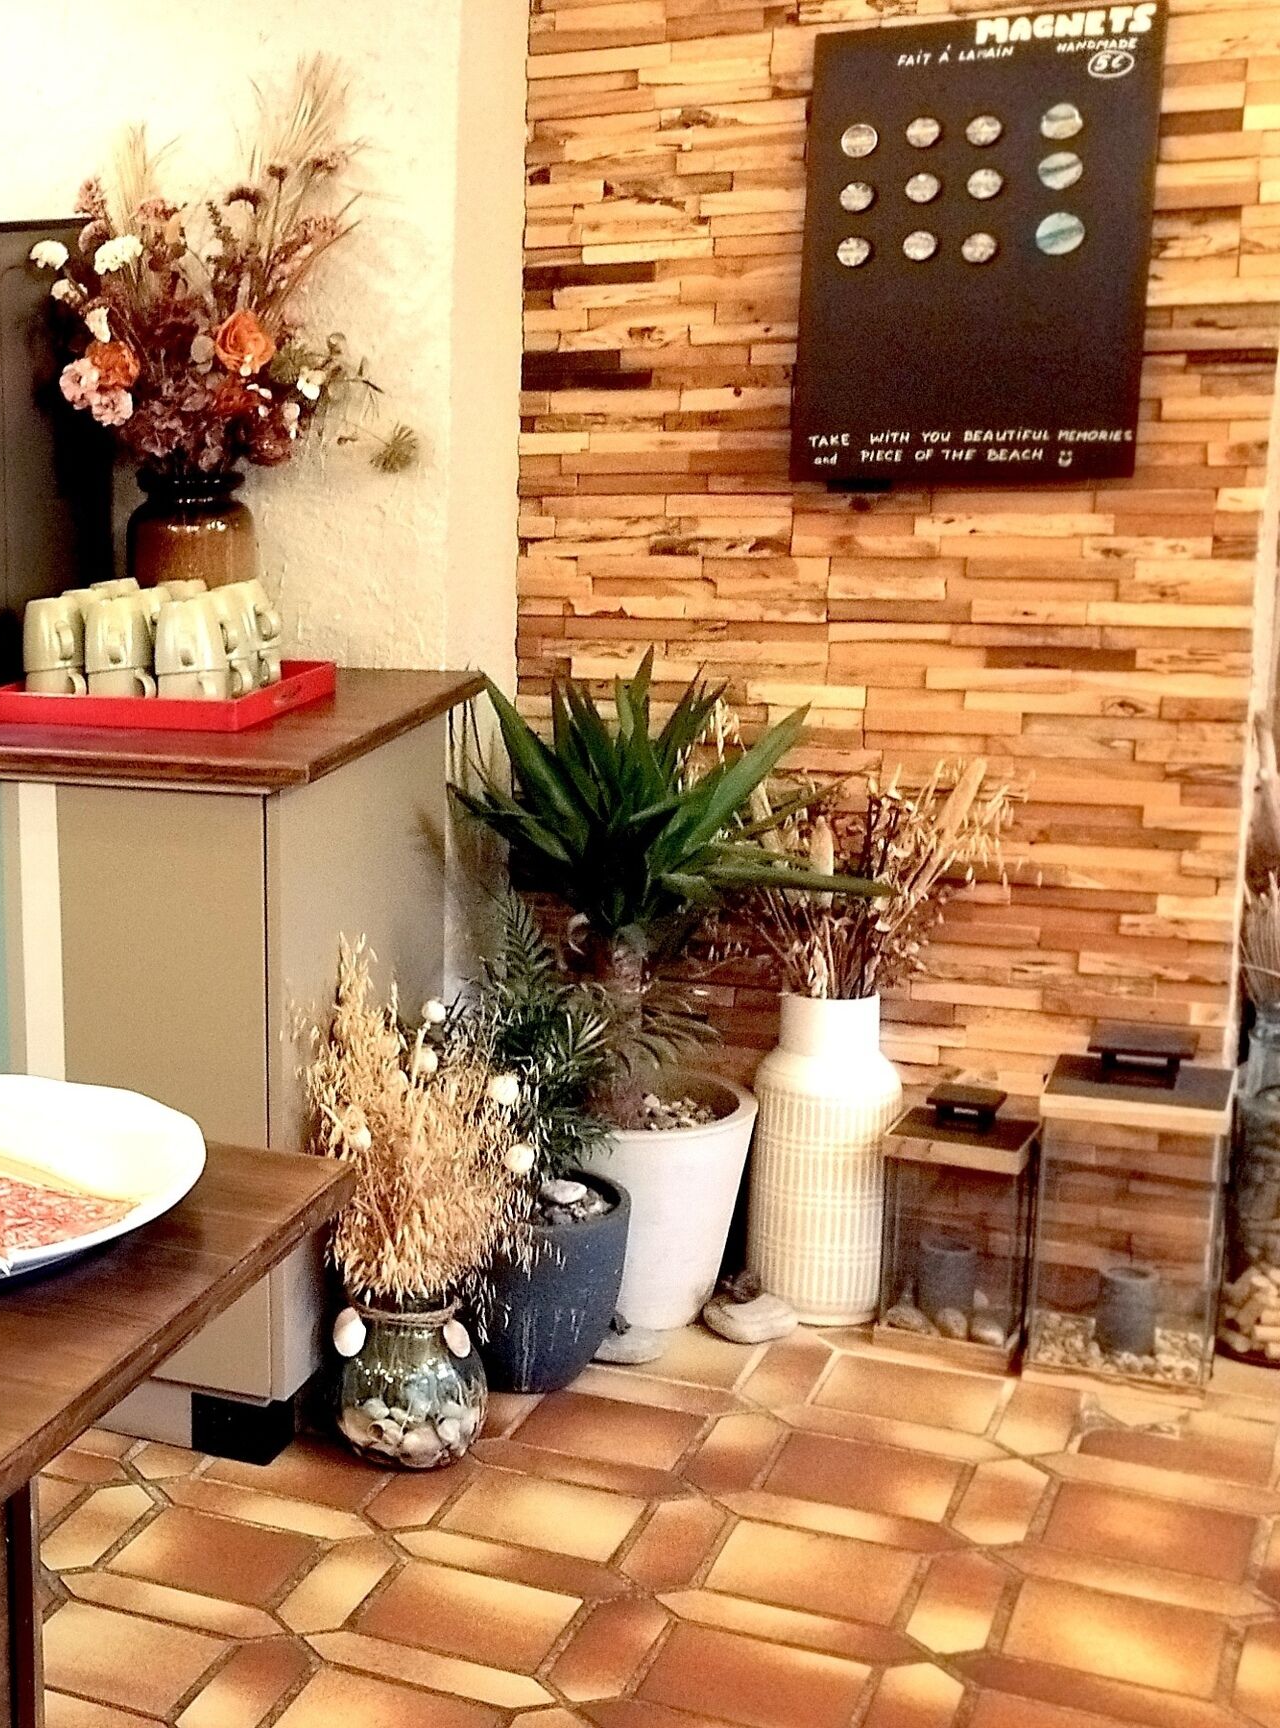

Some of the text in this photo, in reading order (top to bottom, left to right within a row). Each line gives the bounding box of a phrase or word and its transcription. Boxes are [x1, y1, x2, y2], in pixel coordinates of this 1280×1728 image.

[975, 3, 1157, 45] MAGNETS
[1056, 37, 1138, 53] HANDMADE
[808, 433, 851, 448] TAKE
[921, 431, 951, 443] YOU
[1058, 429, 1133, 442] MEMORIES
[814, 448, 1043, 465] and PIECE OF THE BEACH
